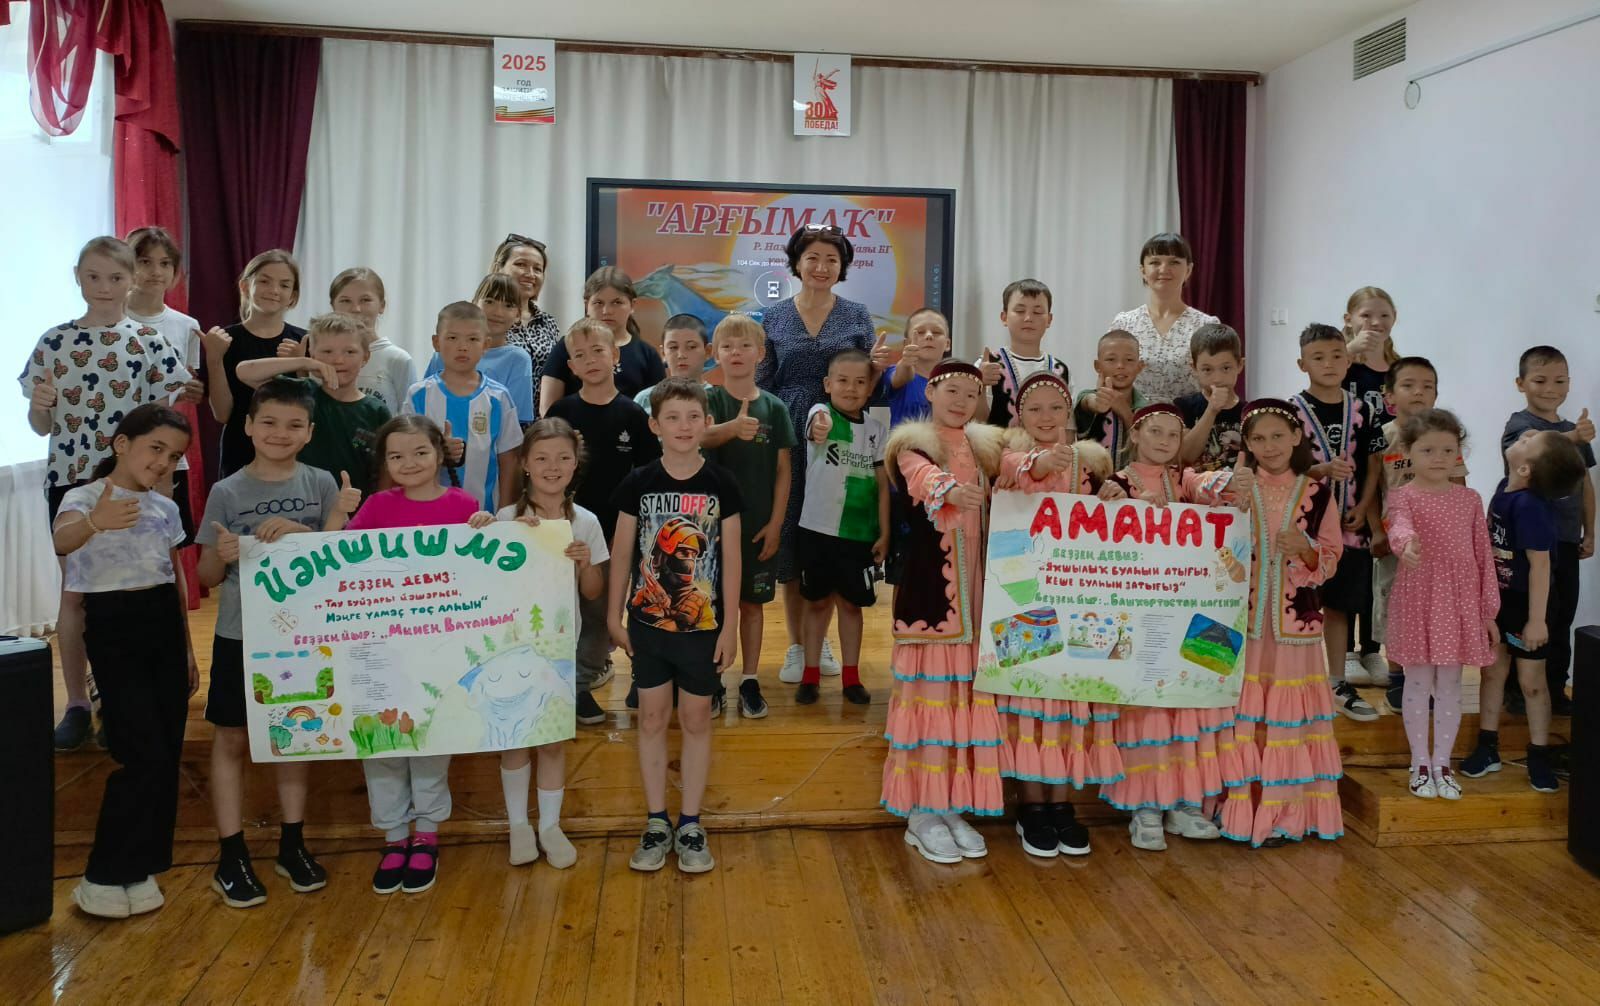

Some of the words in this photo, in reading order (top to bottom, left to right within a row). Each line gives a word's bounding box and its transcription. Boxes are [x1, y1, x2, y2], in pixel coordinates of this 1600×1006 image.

[501, 53, 547, 72] 2025
[804, 120, 839, 131] ПОБЕДА!
[255, 498, 306, 516] GOOD
[640, 493, 707, 515] STANDOFF
[707, 496, 717, 517] 2
[1029, 496, 1235, 549] АМАНАТ
